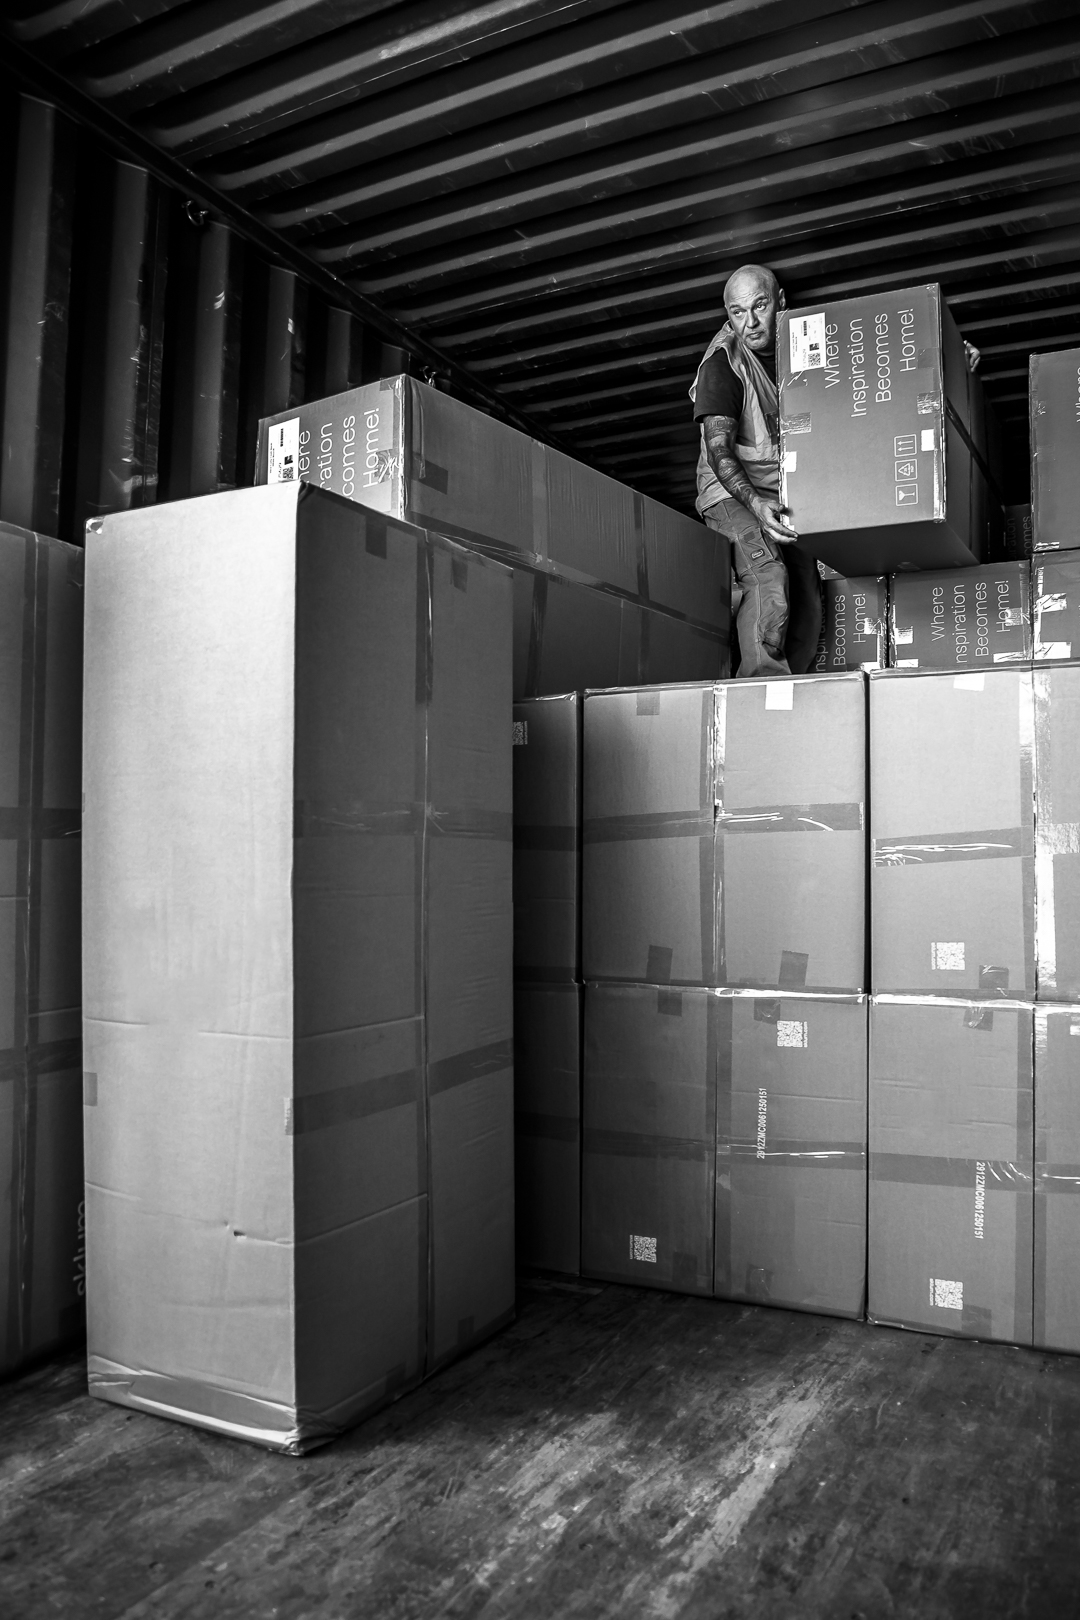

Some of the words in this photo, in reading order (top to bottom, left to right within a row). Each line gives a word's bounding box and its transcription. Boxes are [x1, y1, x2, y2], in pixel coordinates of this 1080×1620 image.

[824, 323, 840, 389] Where
[847, 318, 870, 417] Inspiration
[875, 313, 891, 403] Becomes
[897, 308, 917, 372] Home!
[342, 415, 356, 501] comes
[362, 407, 380, 489] Home!
[833, 594, 846, 666] Becomes
[853, 593, 866, 643] Home!
[930, 586, 945, 642] Where
[951, 584, 970, 664] nspiration
[975, 582, 989, 657] Becomes
[994, 580, 1011, 633] Home!
